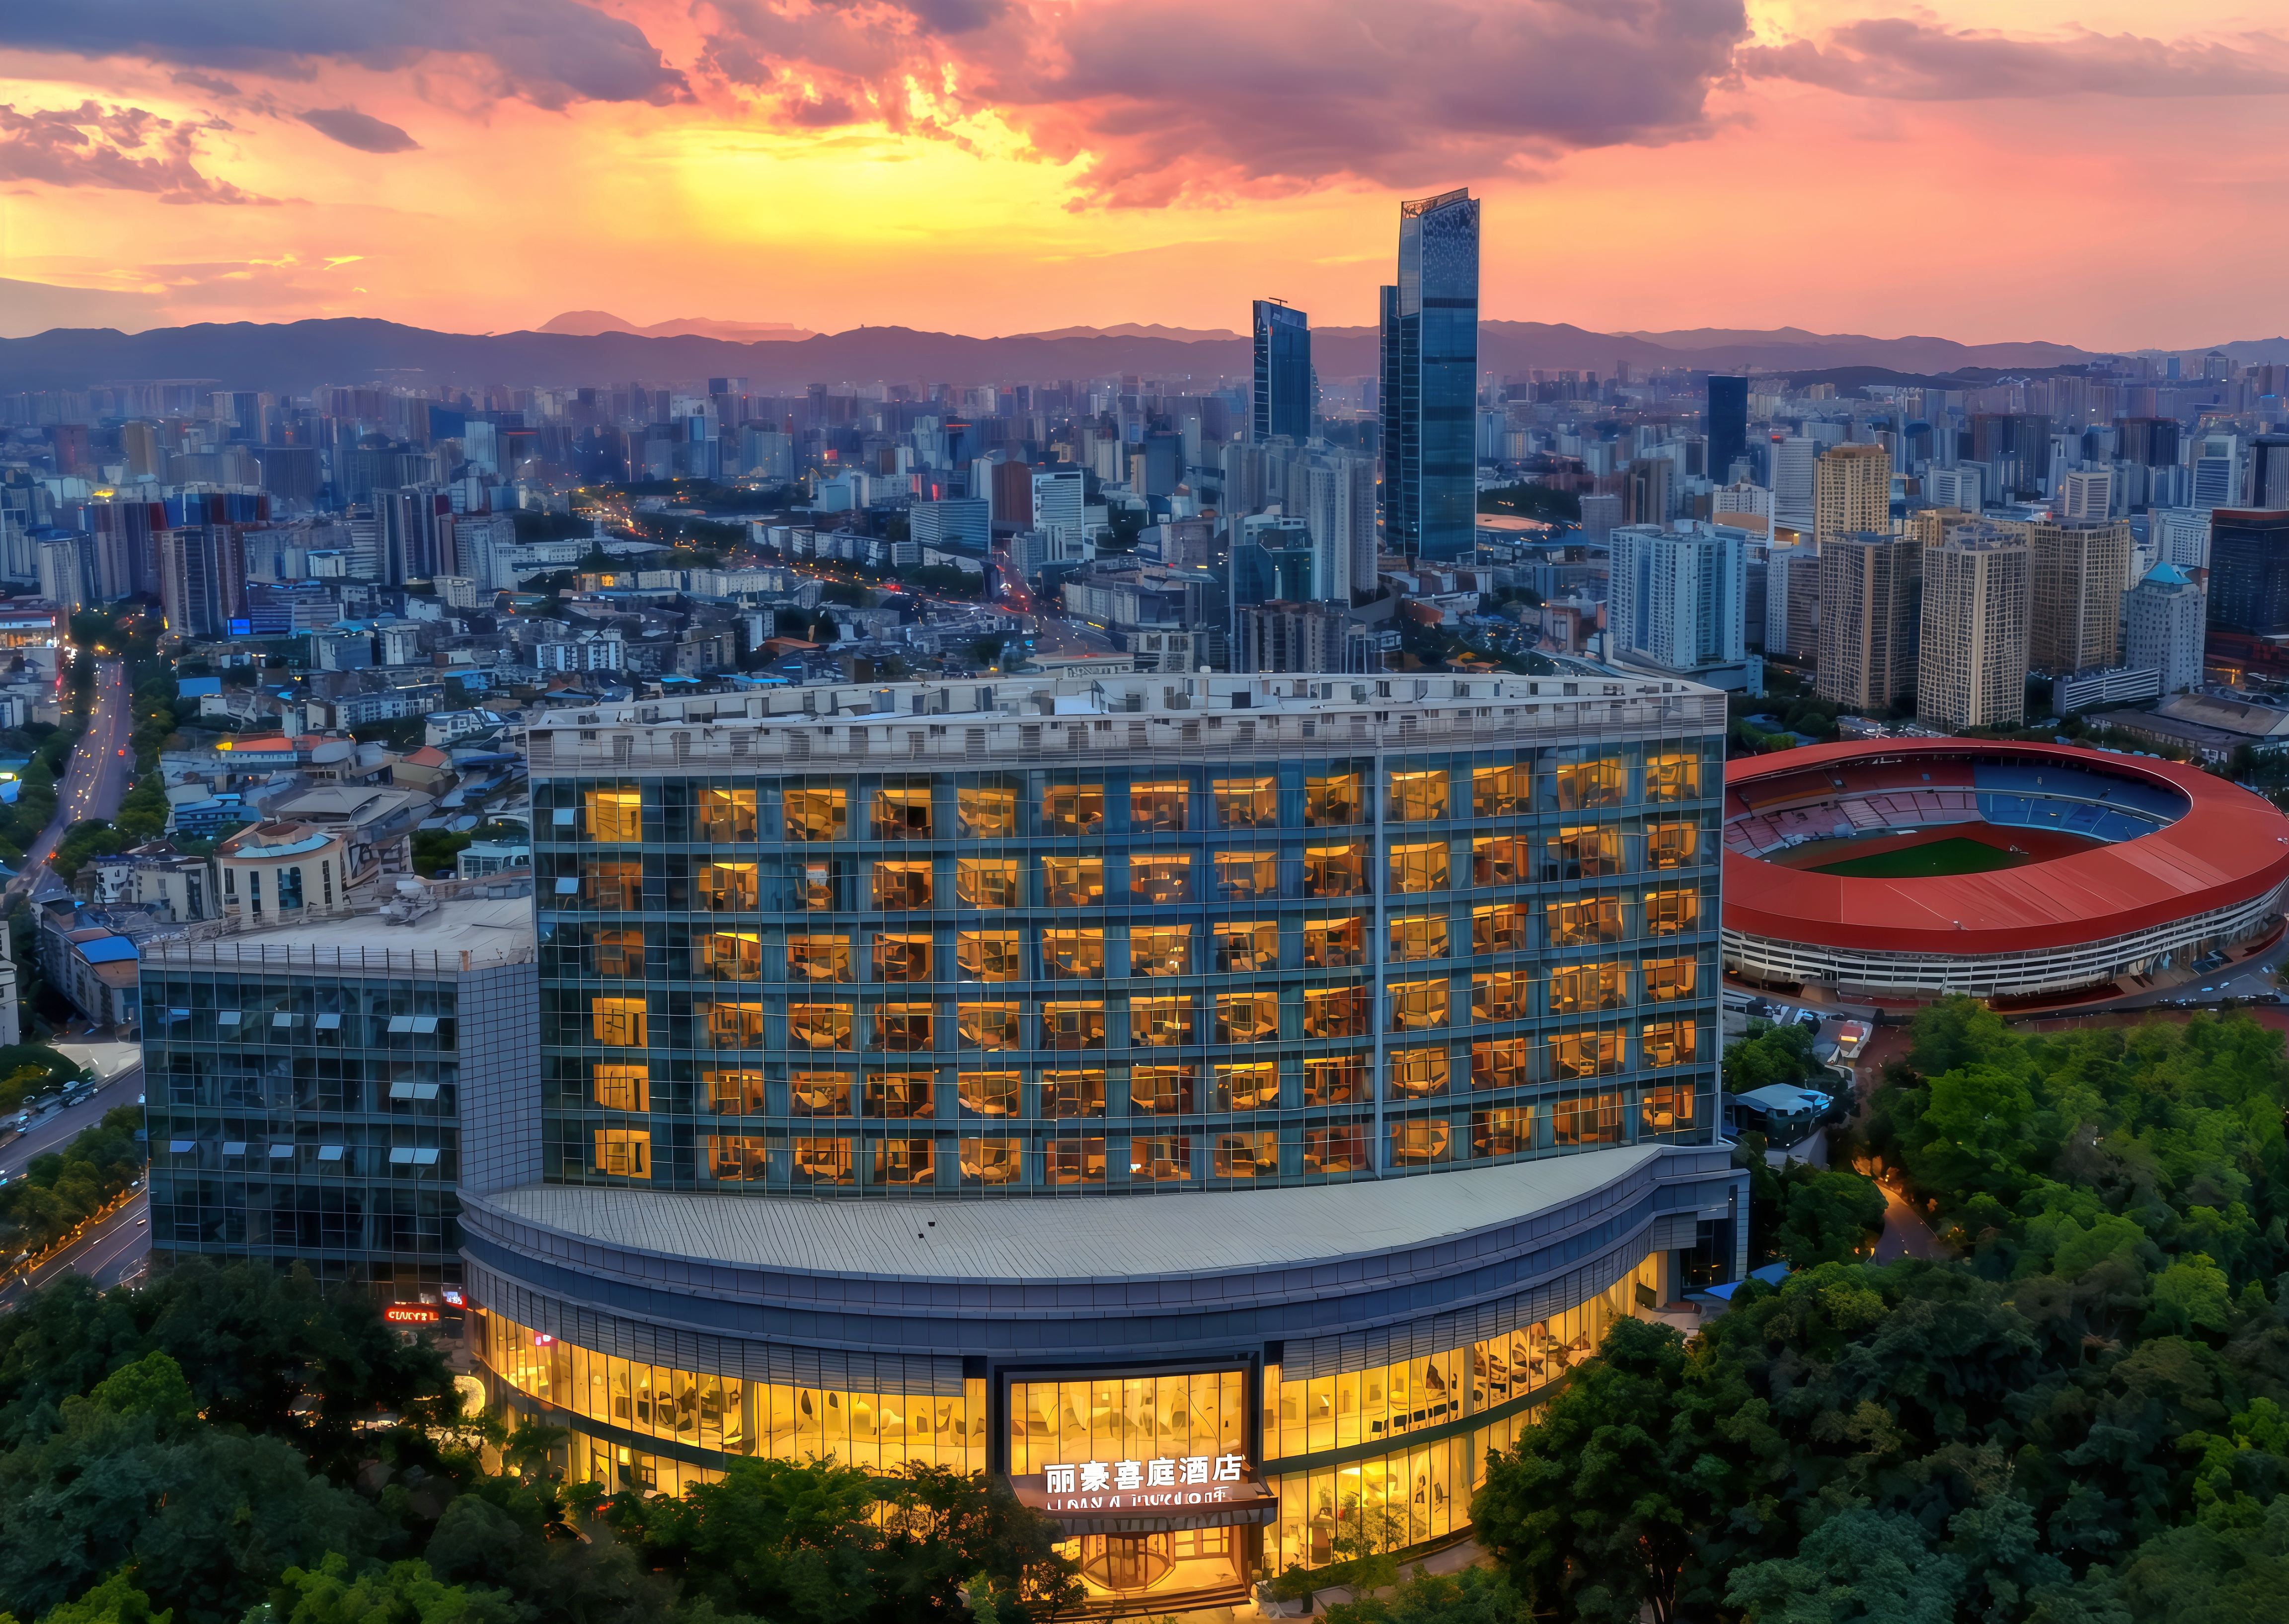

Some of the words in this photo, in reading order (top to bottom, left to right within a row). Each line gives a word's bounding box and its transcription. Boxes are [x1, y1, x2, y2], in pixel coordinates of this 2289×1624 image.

[1044, 1453, 1243, 1494] 丽豪喜庭酒店
